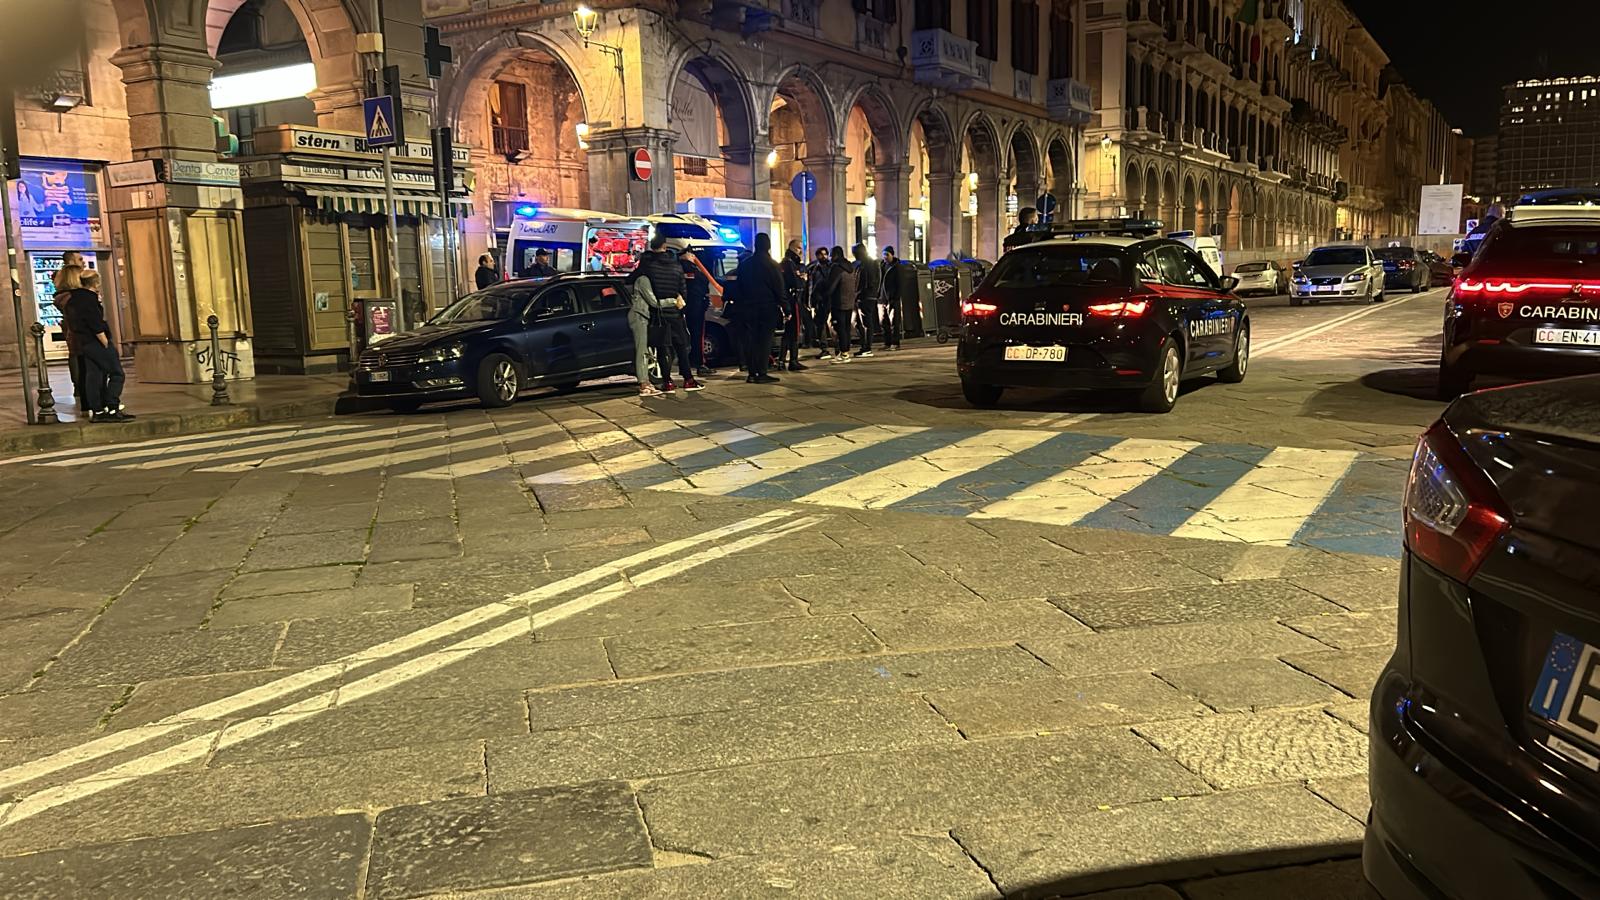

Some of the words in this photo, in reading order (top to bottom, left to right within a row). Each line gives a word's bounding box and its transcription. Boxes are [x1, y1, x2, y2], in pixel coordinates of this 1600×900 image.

[297, 134, 340, 149] stern
[172, 160, 201, 173] Dental
[205, 163, 237, 176] Center
[1000, 313, 1083, 326] CARABINIERI
[1520, 305, 1600, 320] CARABIN
[1538, 330, 1554, 342] CC
[1007, 348, 1020, 359] CC
